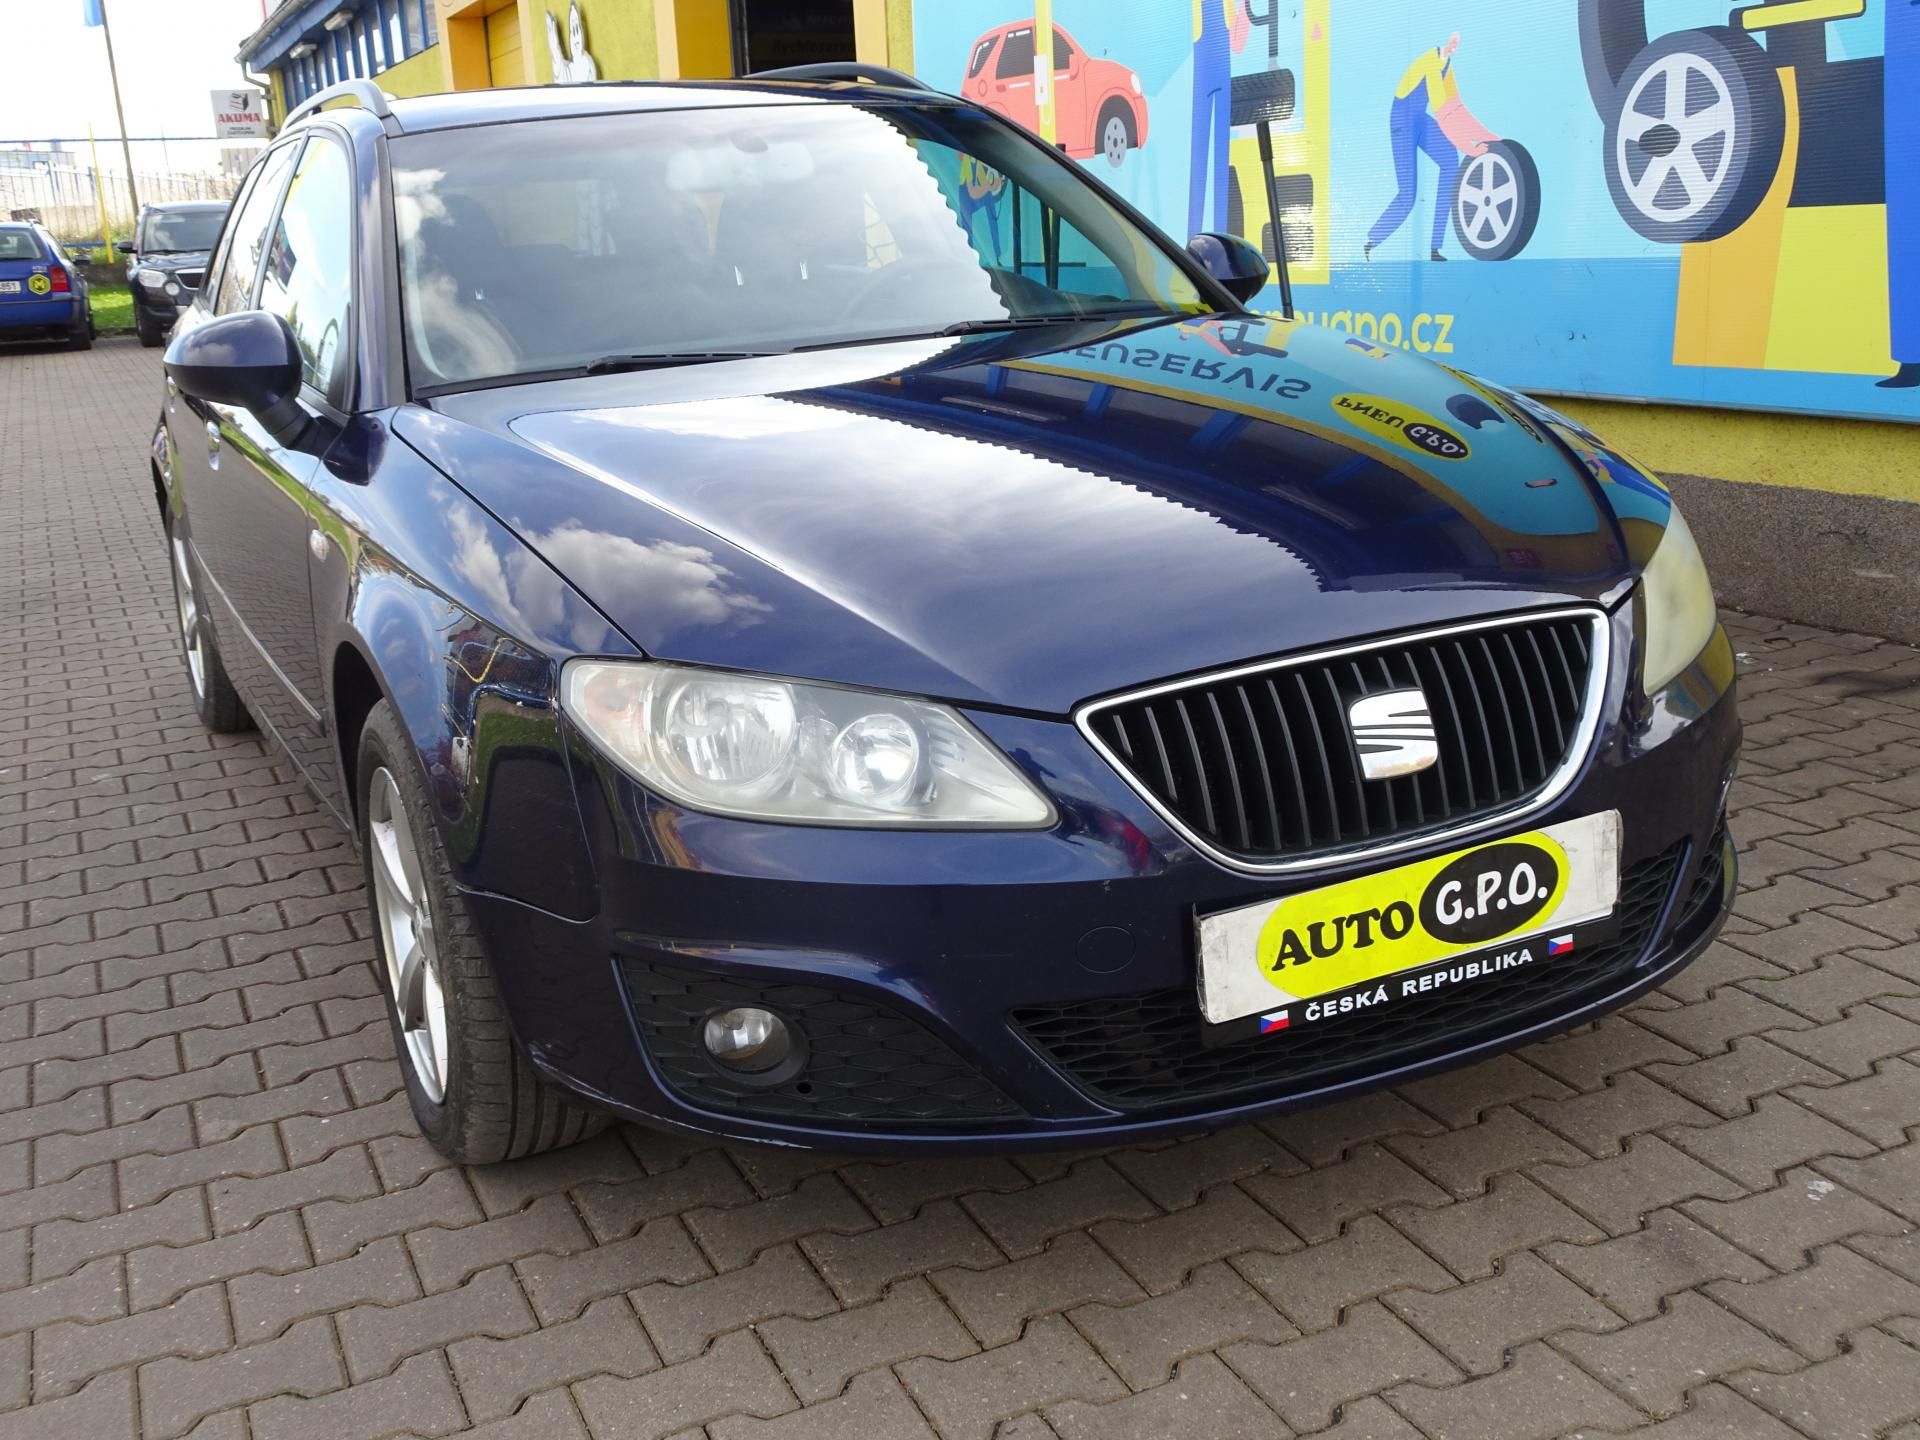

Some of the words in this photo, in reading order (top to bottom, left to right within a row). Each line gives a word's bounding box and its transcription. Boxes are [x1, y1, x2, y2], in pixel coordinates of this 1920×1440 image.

[218, 112, 261, 123] AKUMA
[1271, 900, 1415, 971] AUTO
[1435, 862, 1549, 926] G.P.O.
[1305, 984, 1388, 1022] ČESKÁ
[1401, 947, 1534, 998] REPUBLIKA
